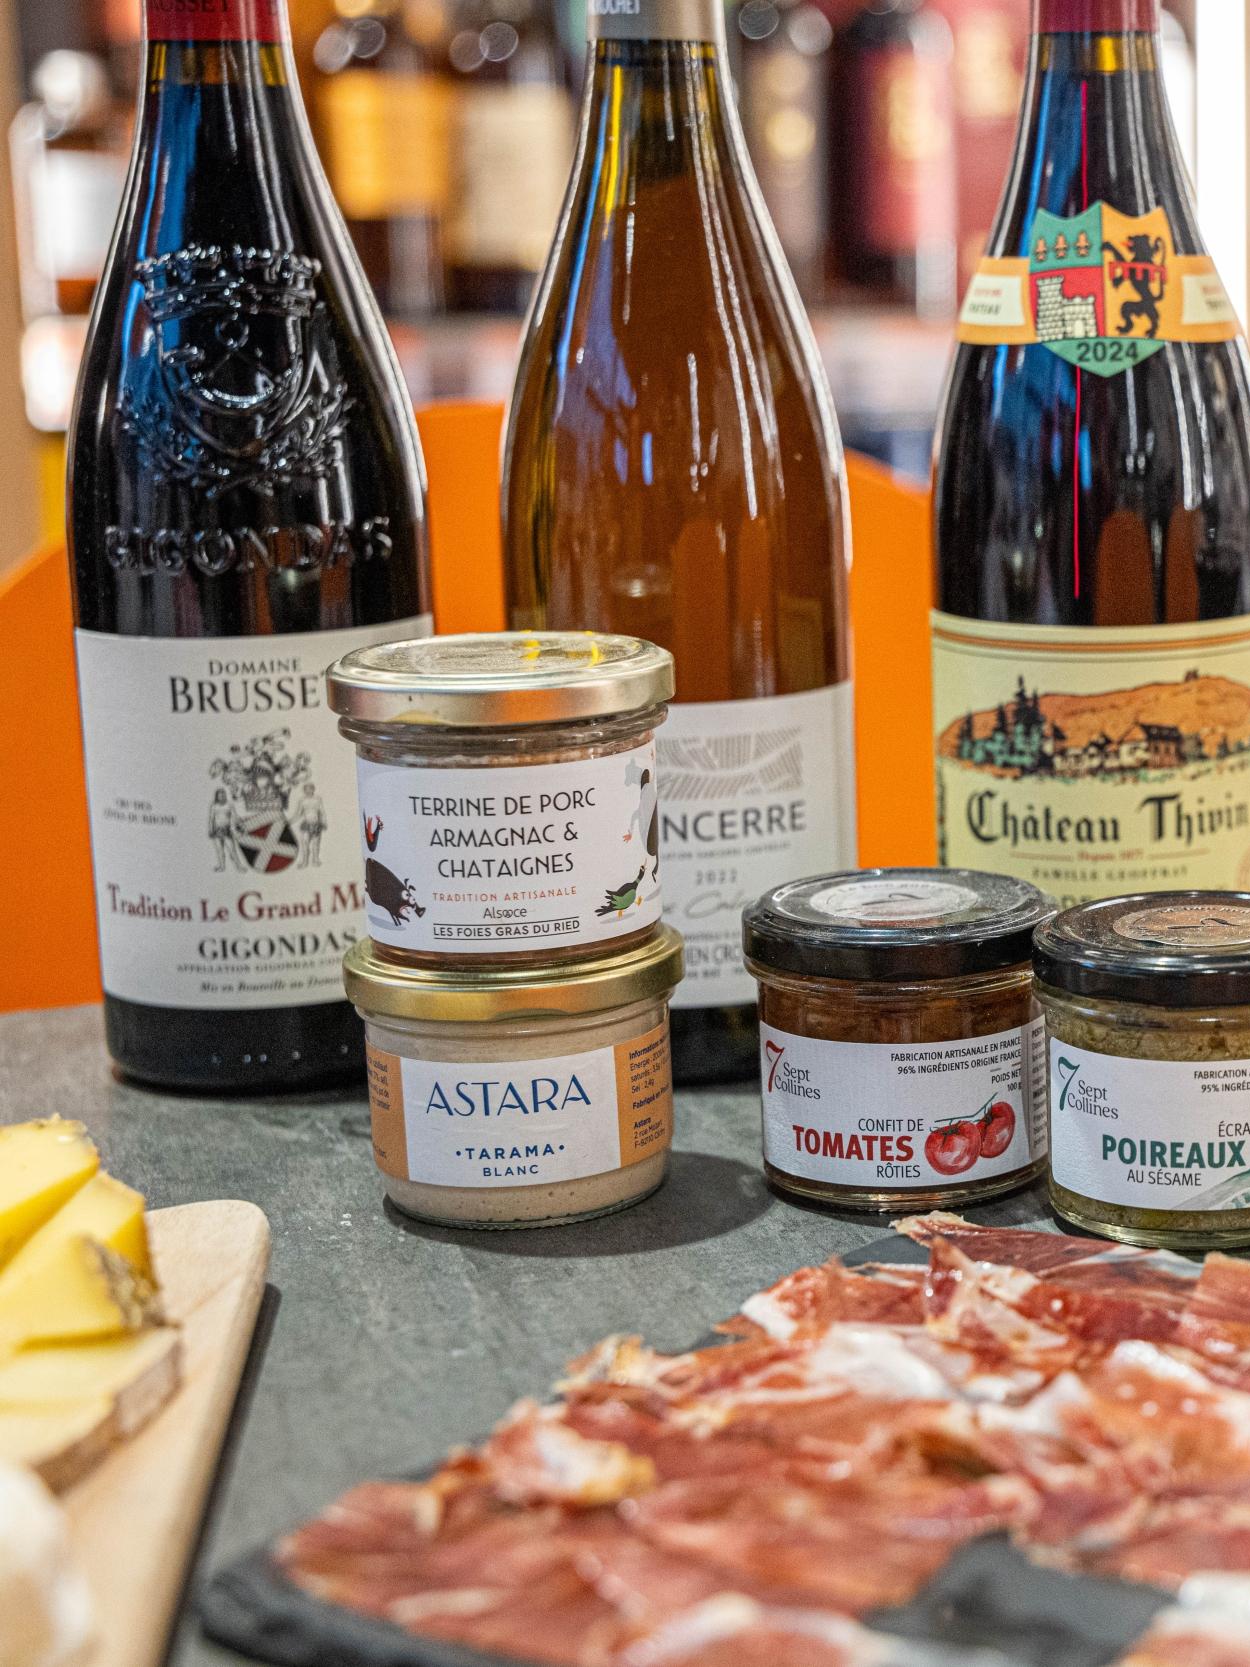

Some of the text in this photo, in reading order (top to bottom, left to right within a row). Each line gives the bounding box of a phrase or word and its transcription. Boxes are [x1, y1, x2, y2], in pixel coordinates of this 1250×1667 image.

[1077, 342, 1139, 363] 2024
[104, 515, 392, 576] GIGONDAS
[209, 657, 300, 676] DOMAINE
[170, 669, 326, 714] BRUSSE
[409, 787, 596, 816] TERRINE DE PORC
[662, 801, 808, 843] NCERRE
[967, 790, 1250, 847] Château Thivin
[430, 822, 579, 847] ARMAGNAC &
[438, 853, 574, 878] CHATAIGNES
[107, 882, 366, 923] Tradition Le Grand M
[432, 886, 577, 902] TRADITION ARTISANALE
[433, 920, 580, 937] LES FOIES GRAS DU RIED
[198, 928, 357, 960] GIGONDAS
[891, 1036, 1021, 1062] FABRICATION ARTISANALE EN FRANCE
[766, 1040, 811, 1094] 7 Sept
[897, 1049, 1021, 1075] 96% INGRÉDIENTS ORIGINE FRANCE
[774, 1075, 821, 1099] Collines
[991, 1068, 1021, 1084] POIDS NET
[1057, 1056, 1108, 1112] 7 Sept
[1194, 1070, 1247, 1080] FABRICATION
[426, 1074, 592, 1117] ASTARA
[1201, 1084, 1220, 1093] 95%
[1067, 1092, 1119, 1120] Collines
[858, 1118, 924, 1132] CONFIT DE
[466, 1144, 555, 1160] TARAMA
[792, 1125, 914, 1162] TOMATES
[1102, 1134, 1246, 1169] POIREAUX
[483, 1164, 539, 1177] BLANC
[876, 1162, 921, 1179] RÔTIES
[1127, 1169, 1202, 1187] AU SÉSAME
